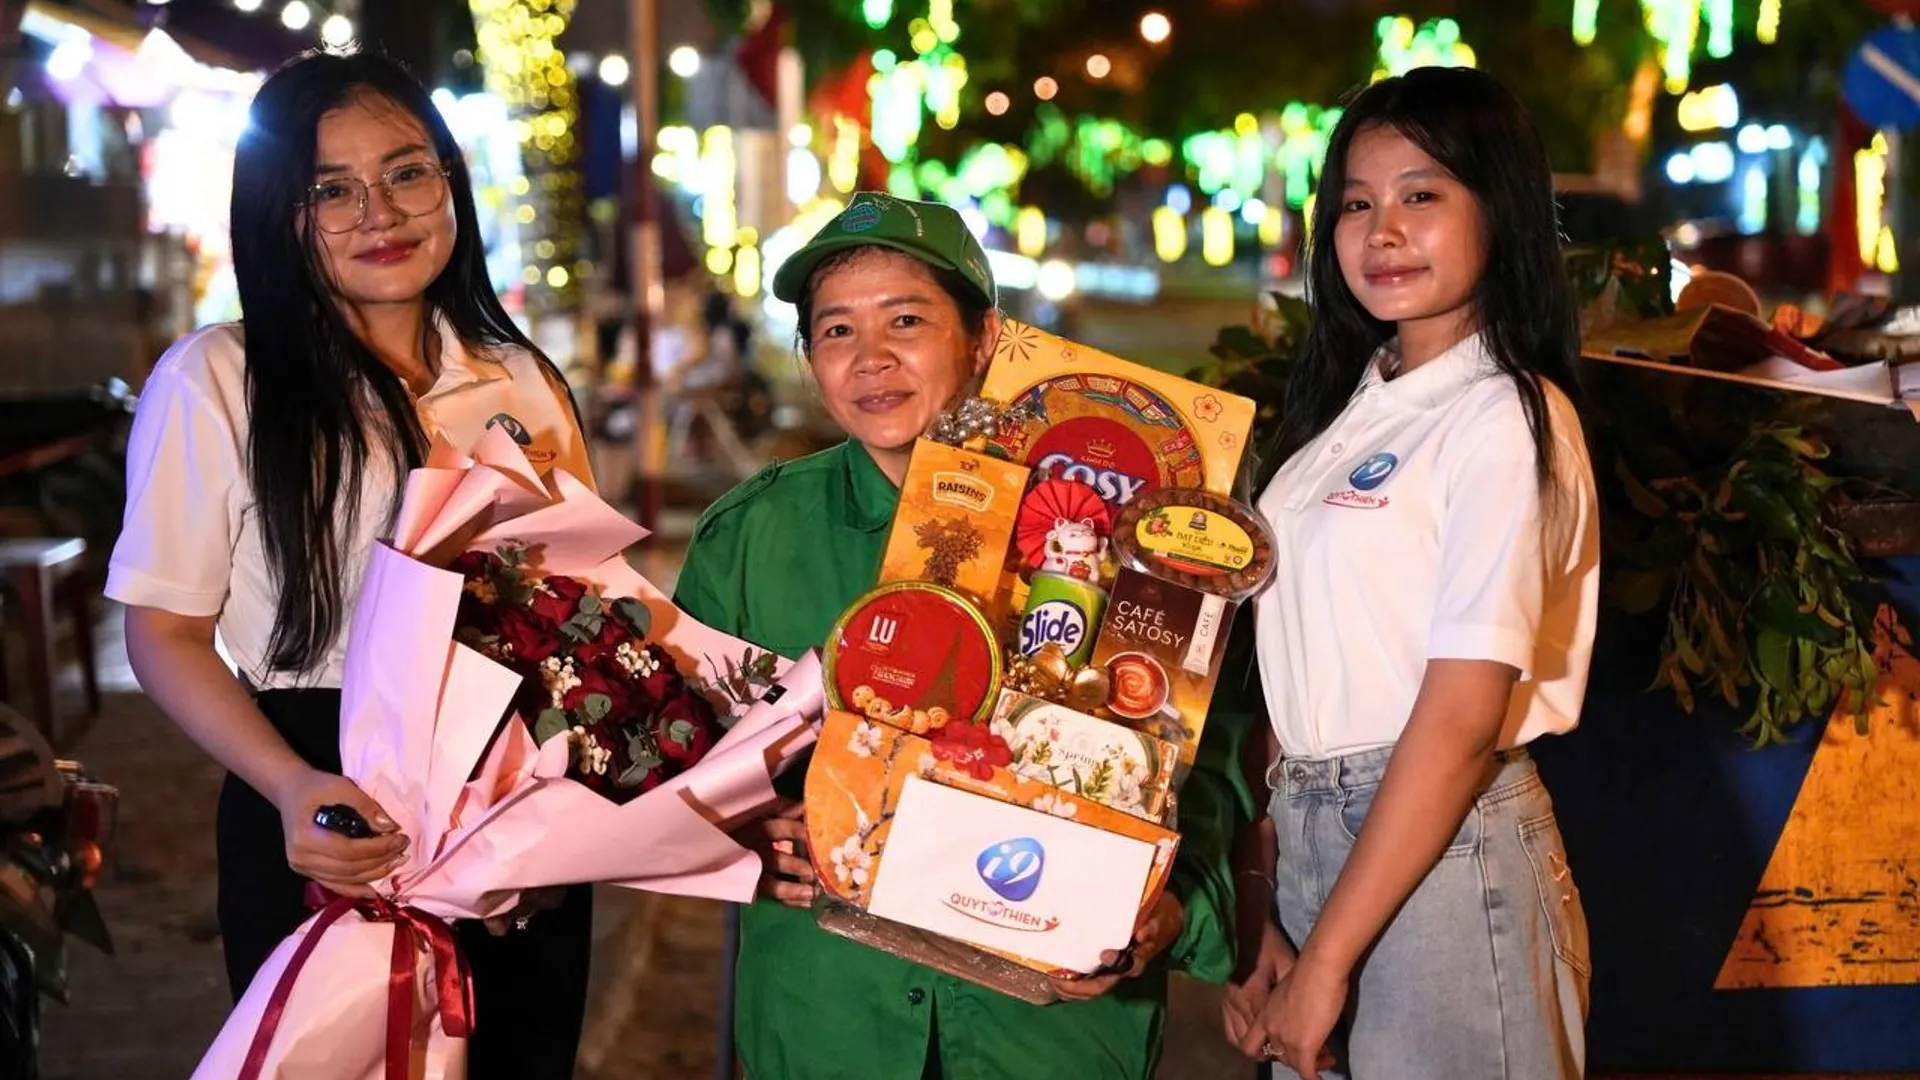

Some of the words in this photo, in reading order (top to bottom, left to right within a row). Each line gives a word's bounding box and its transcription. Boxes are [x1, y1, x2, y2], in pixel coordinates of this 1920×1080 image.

[938, 481, 986, 502] RAISINS
[1117, 600, 1165, 626] CAFÉ
[869, 615, 897, 644] LU
[1021, 609, 1080, 653] Slide
[1112, 615, 1184, 648] SATOSY
